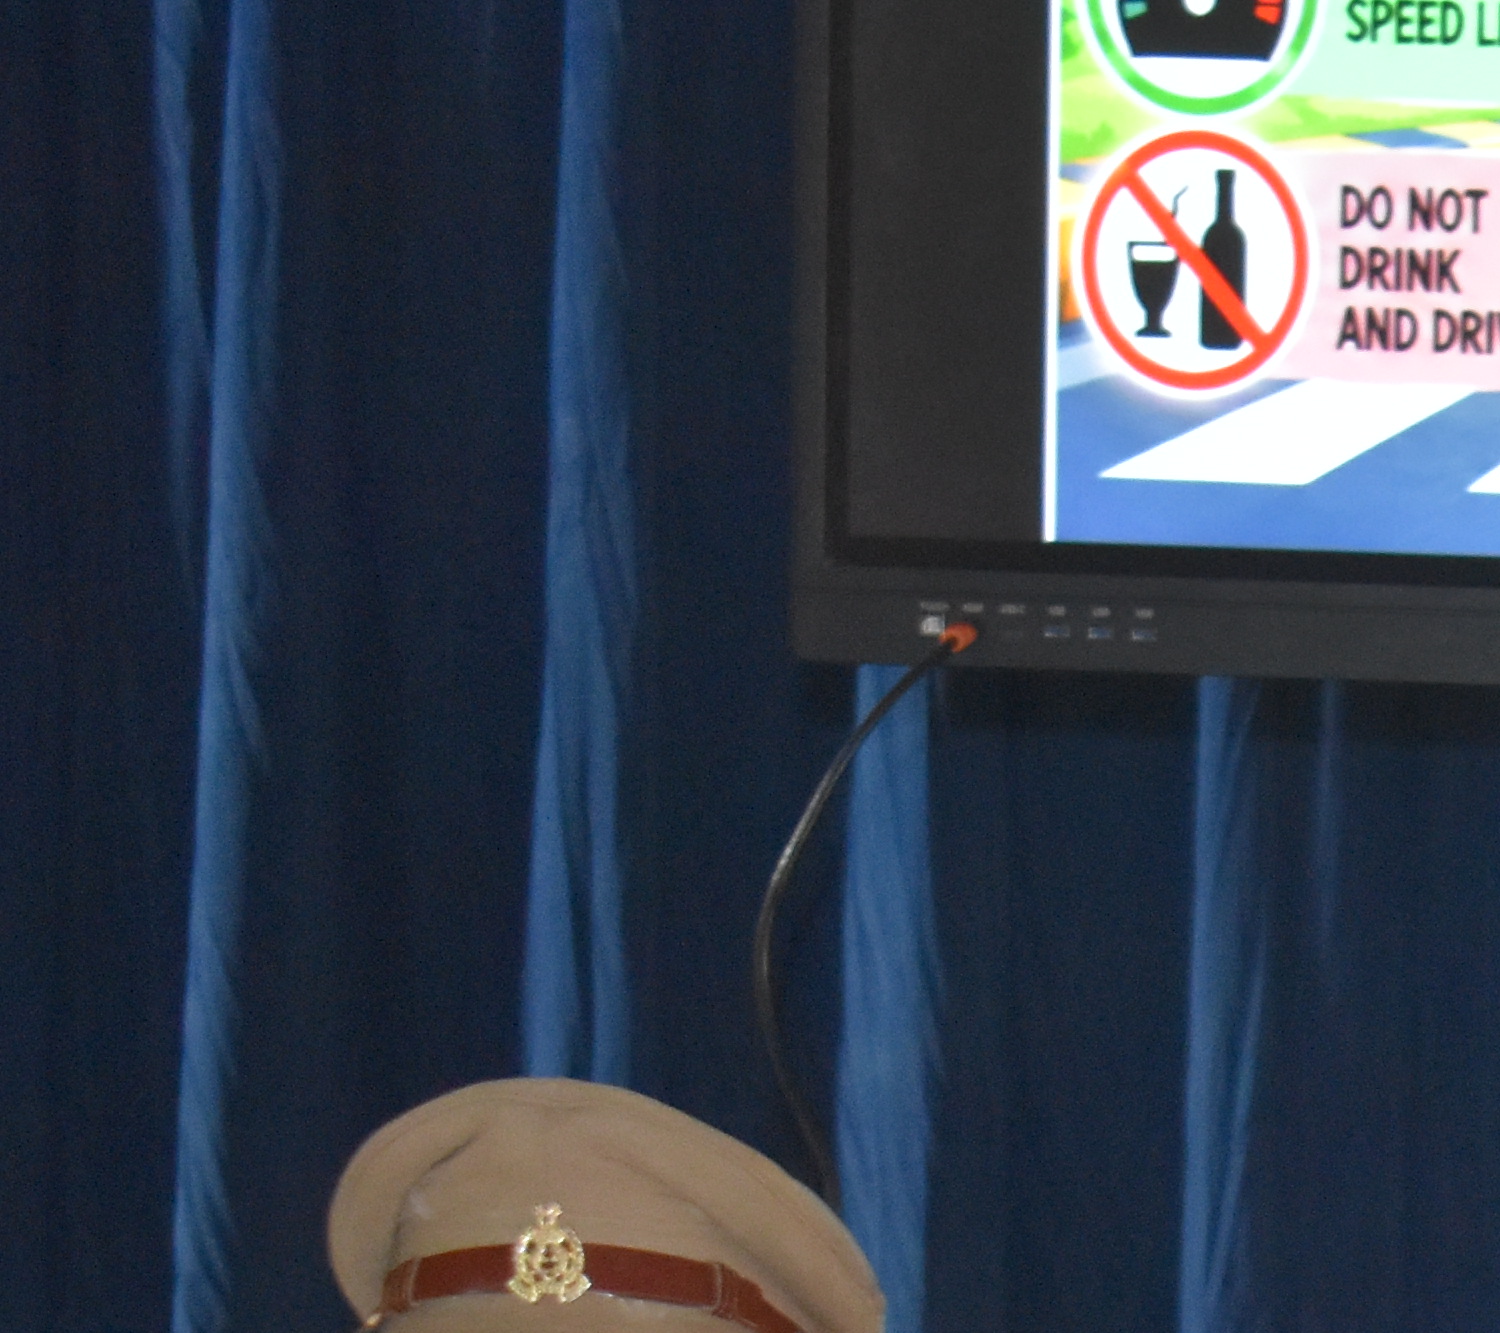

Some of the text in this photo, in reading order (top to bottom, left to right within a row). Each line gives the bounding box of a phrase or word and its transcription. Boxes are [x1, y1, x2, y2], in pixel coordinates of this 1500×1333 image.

[1346, 0, 1464, 44] SPEED
[1339, 184, 1489, 234] DO NOT
[1337, 245, 1463, 295] DRINK
[1336, 306, 1418, 353] AND
